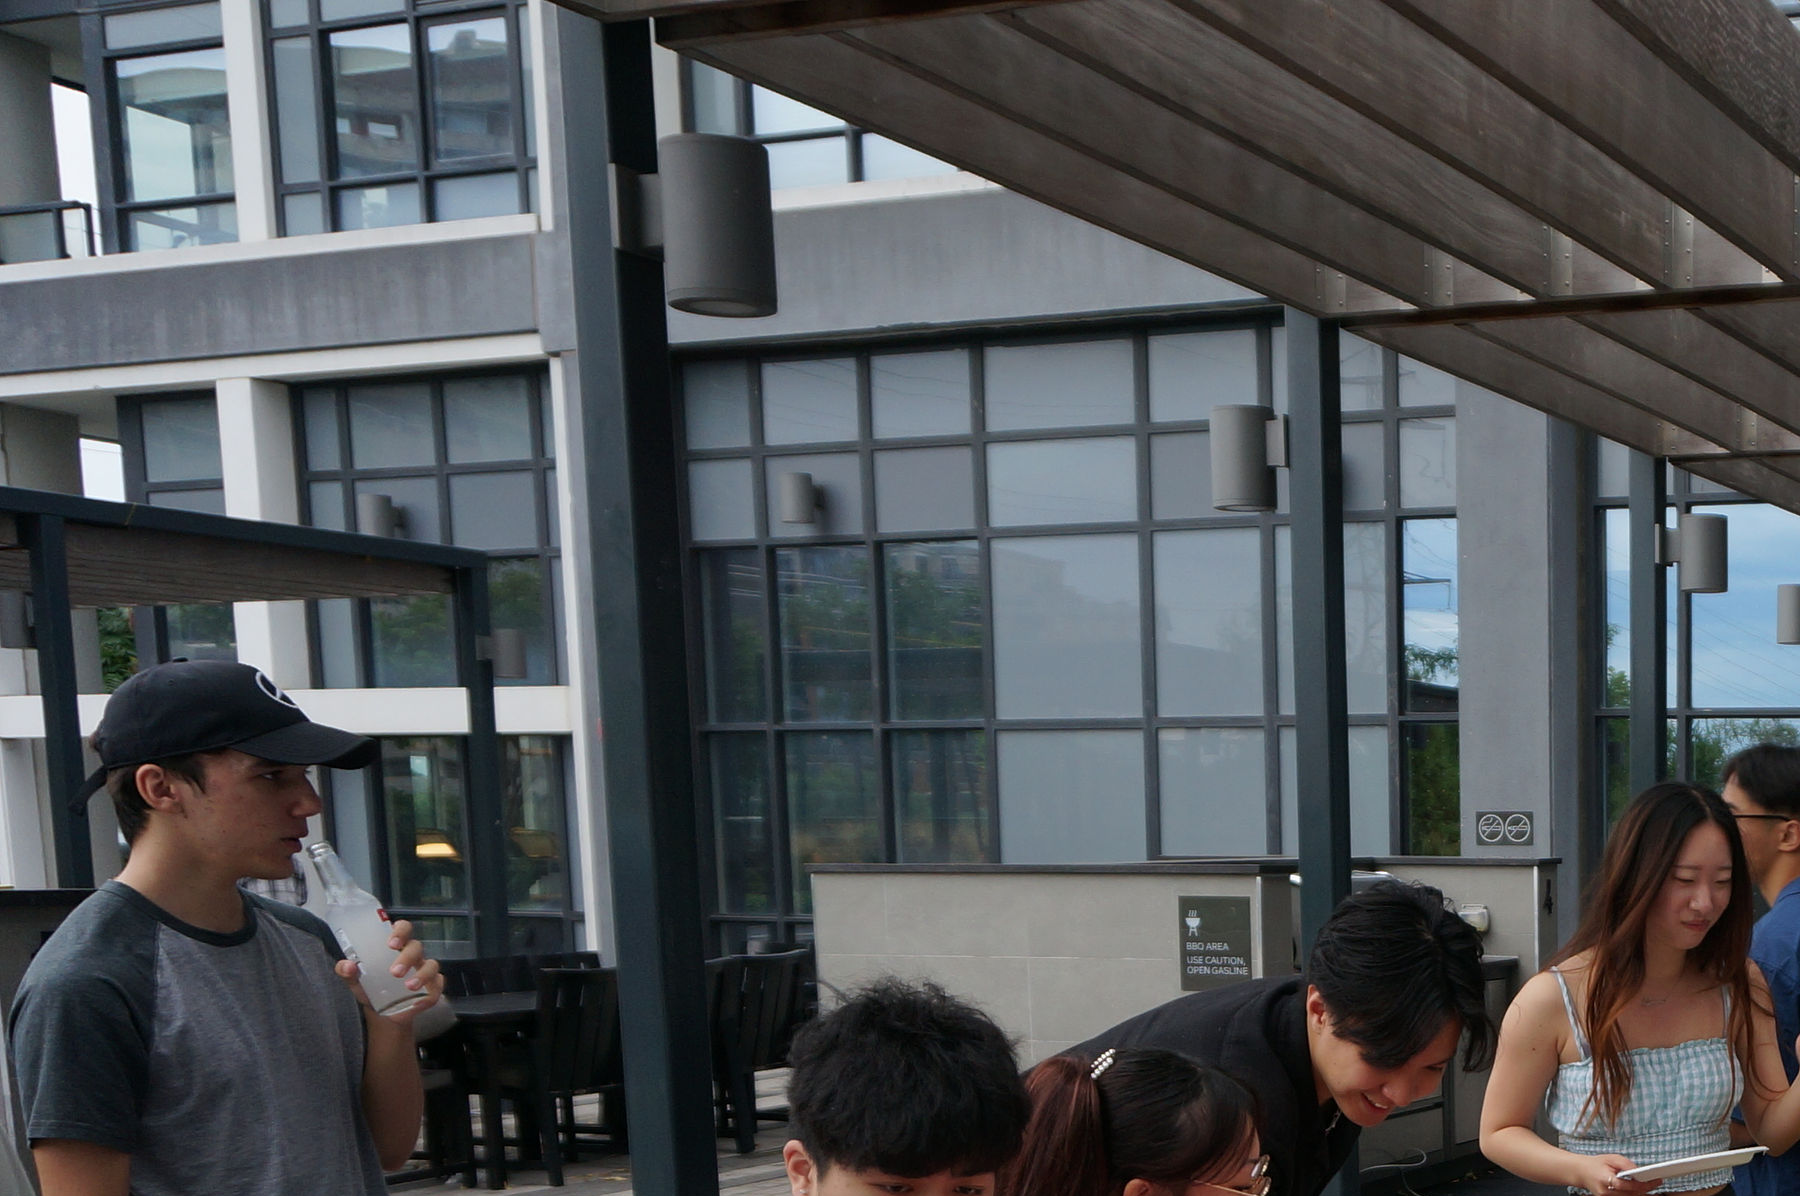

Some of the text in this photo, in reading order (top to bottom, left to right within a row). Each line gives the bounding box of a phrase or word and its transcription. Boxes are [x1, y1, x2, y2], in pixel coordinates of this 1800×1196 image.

[1186, 942, 1204, 950] BBQ
[1186, 956, 1246, 966] USE CAUTION,
[1186, 966, 1248, 975] OPEN GASLINE
